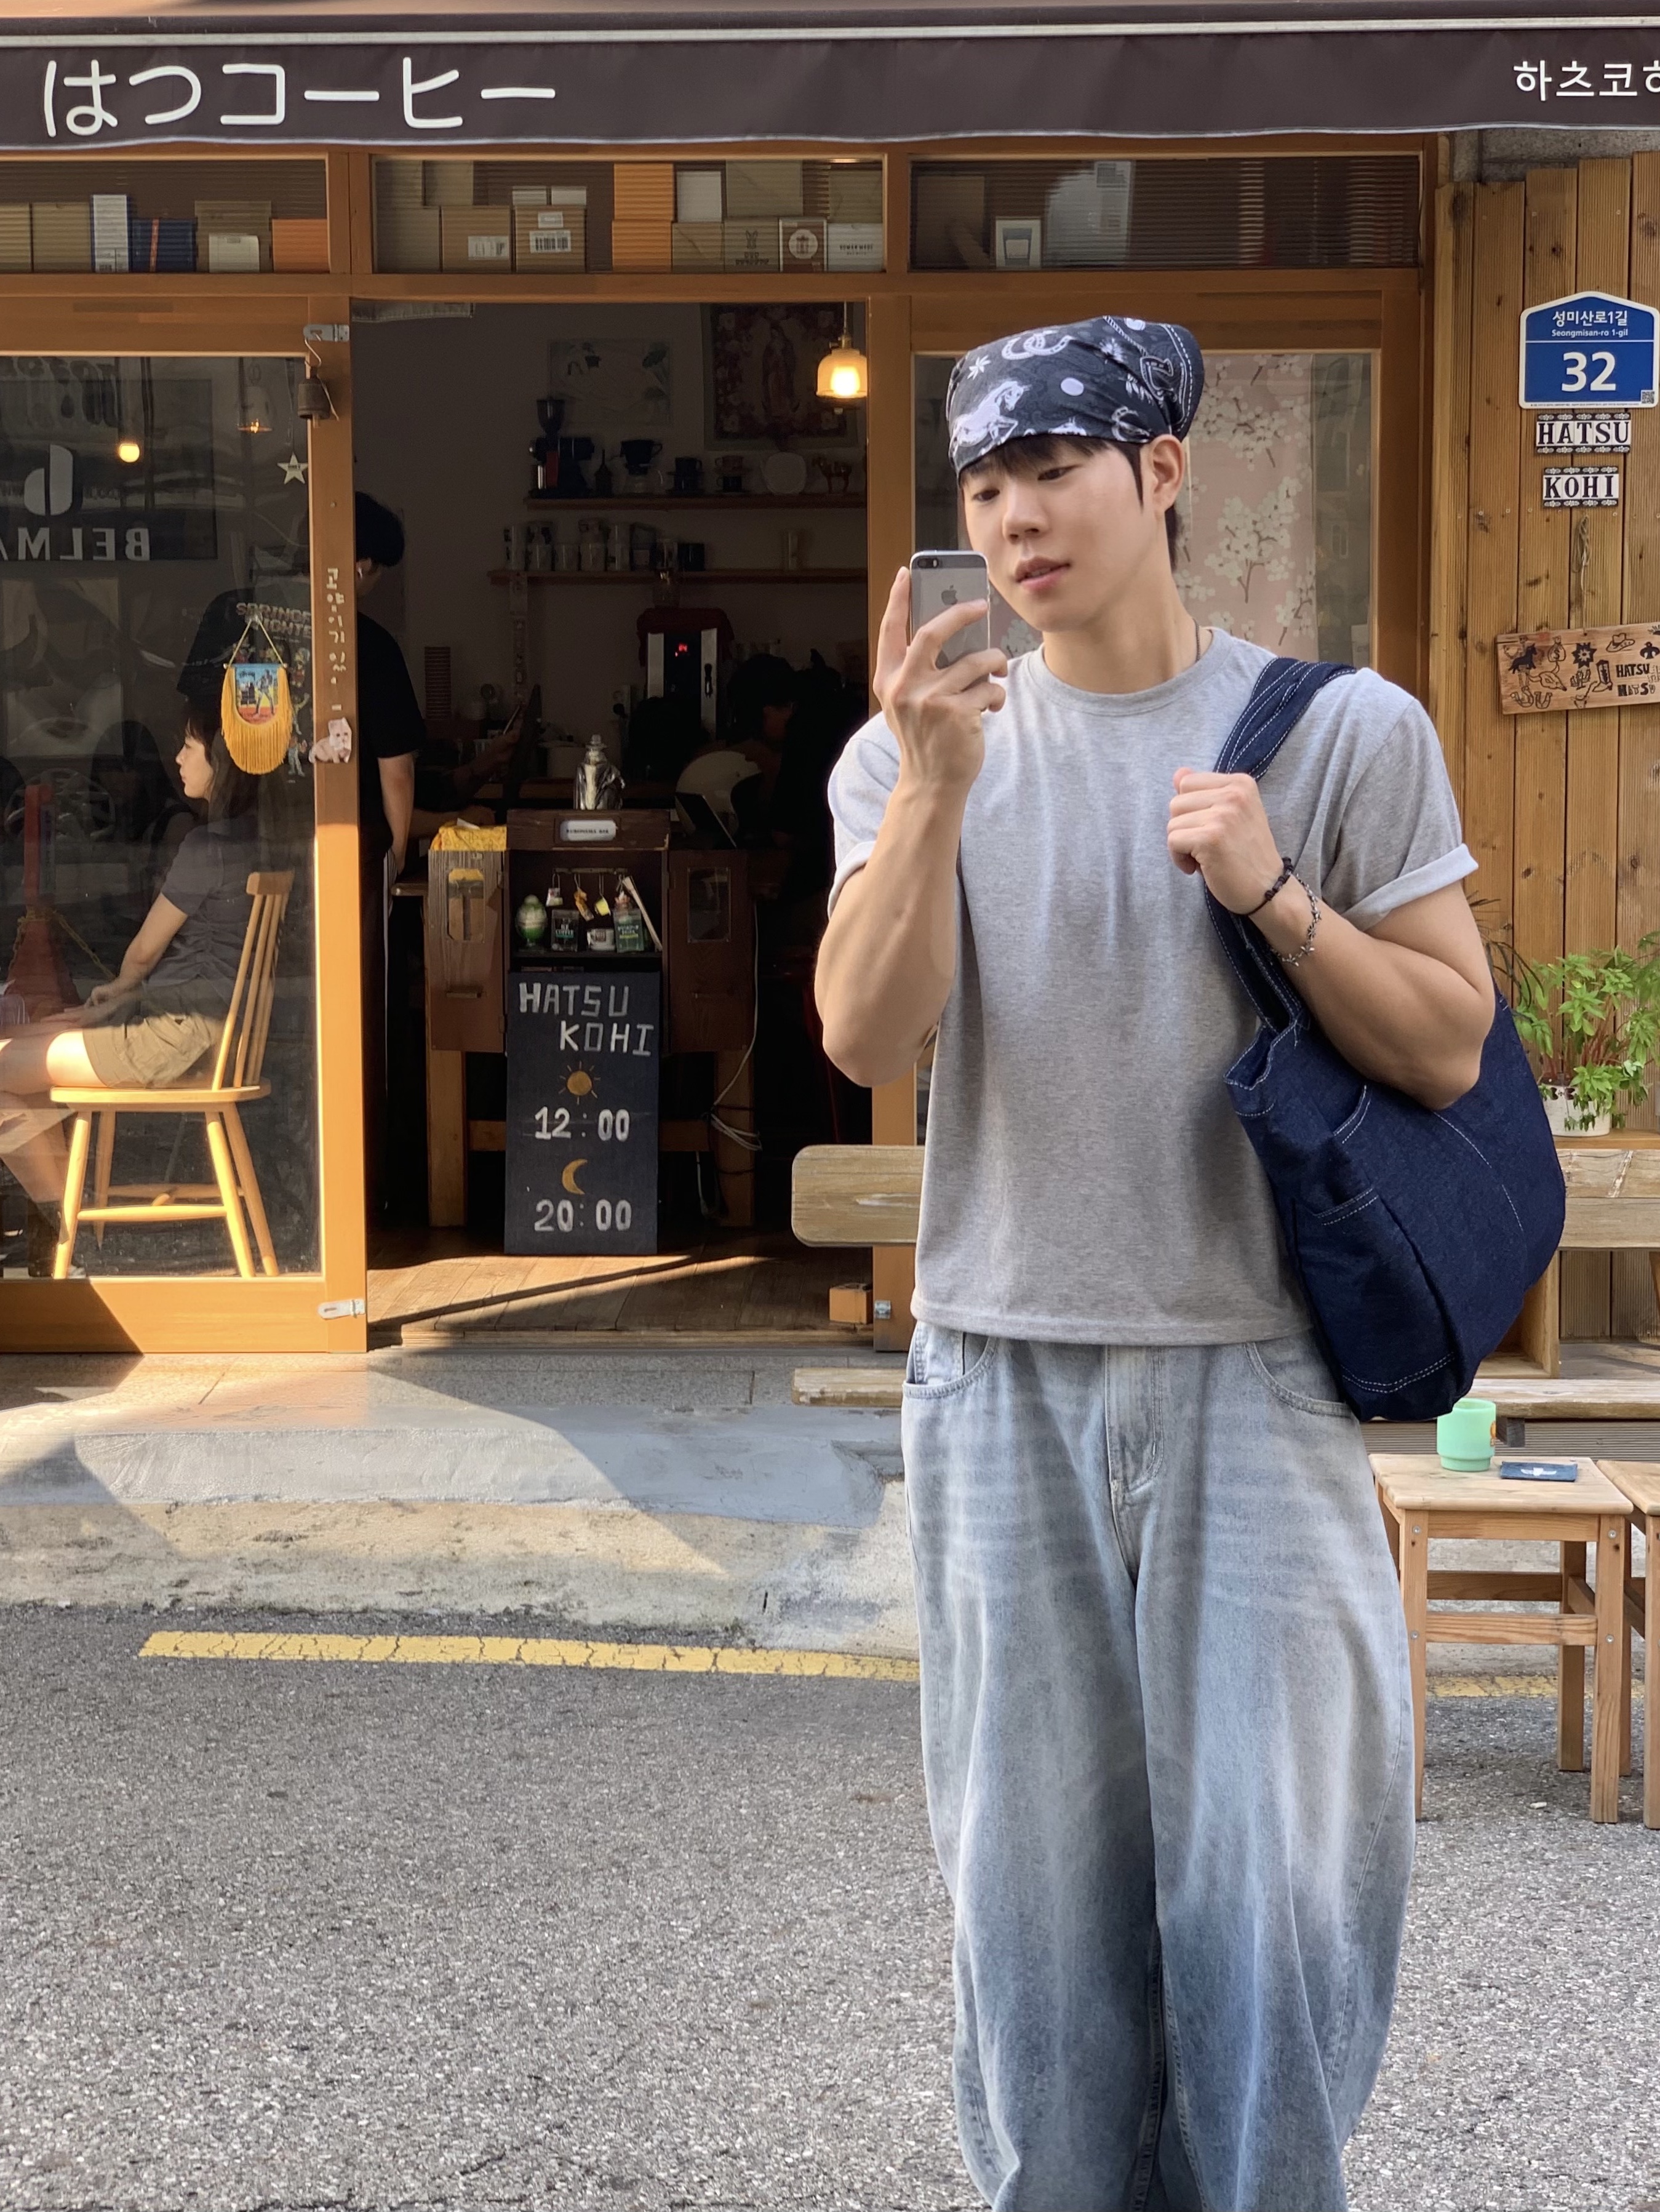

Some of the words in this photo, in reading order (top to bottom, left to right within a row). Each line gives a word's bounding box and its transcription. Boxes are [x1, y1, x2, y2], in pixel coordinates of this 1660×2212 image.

[44, 57, 556, 137] はつコーヒー
[1552, 311, 1628, 327] 성미산로1길
[1551, 329, 1610, 337] Seongmisan-ro
[1611, 329, 1629, 337] 1-gil
[1561, 351, 1616, 392] 32
[1538, 422, 1629, 444] HATSU
[1544, 475, 1614, 498] KOHI
[1616, 664, 1650, 677] HATSU
[519, 983, 629, 1017] HATSU
[560, 1020, 654, 1056] KOHI
